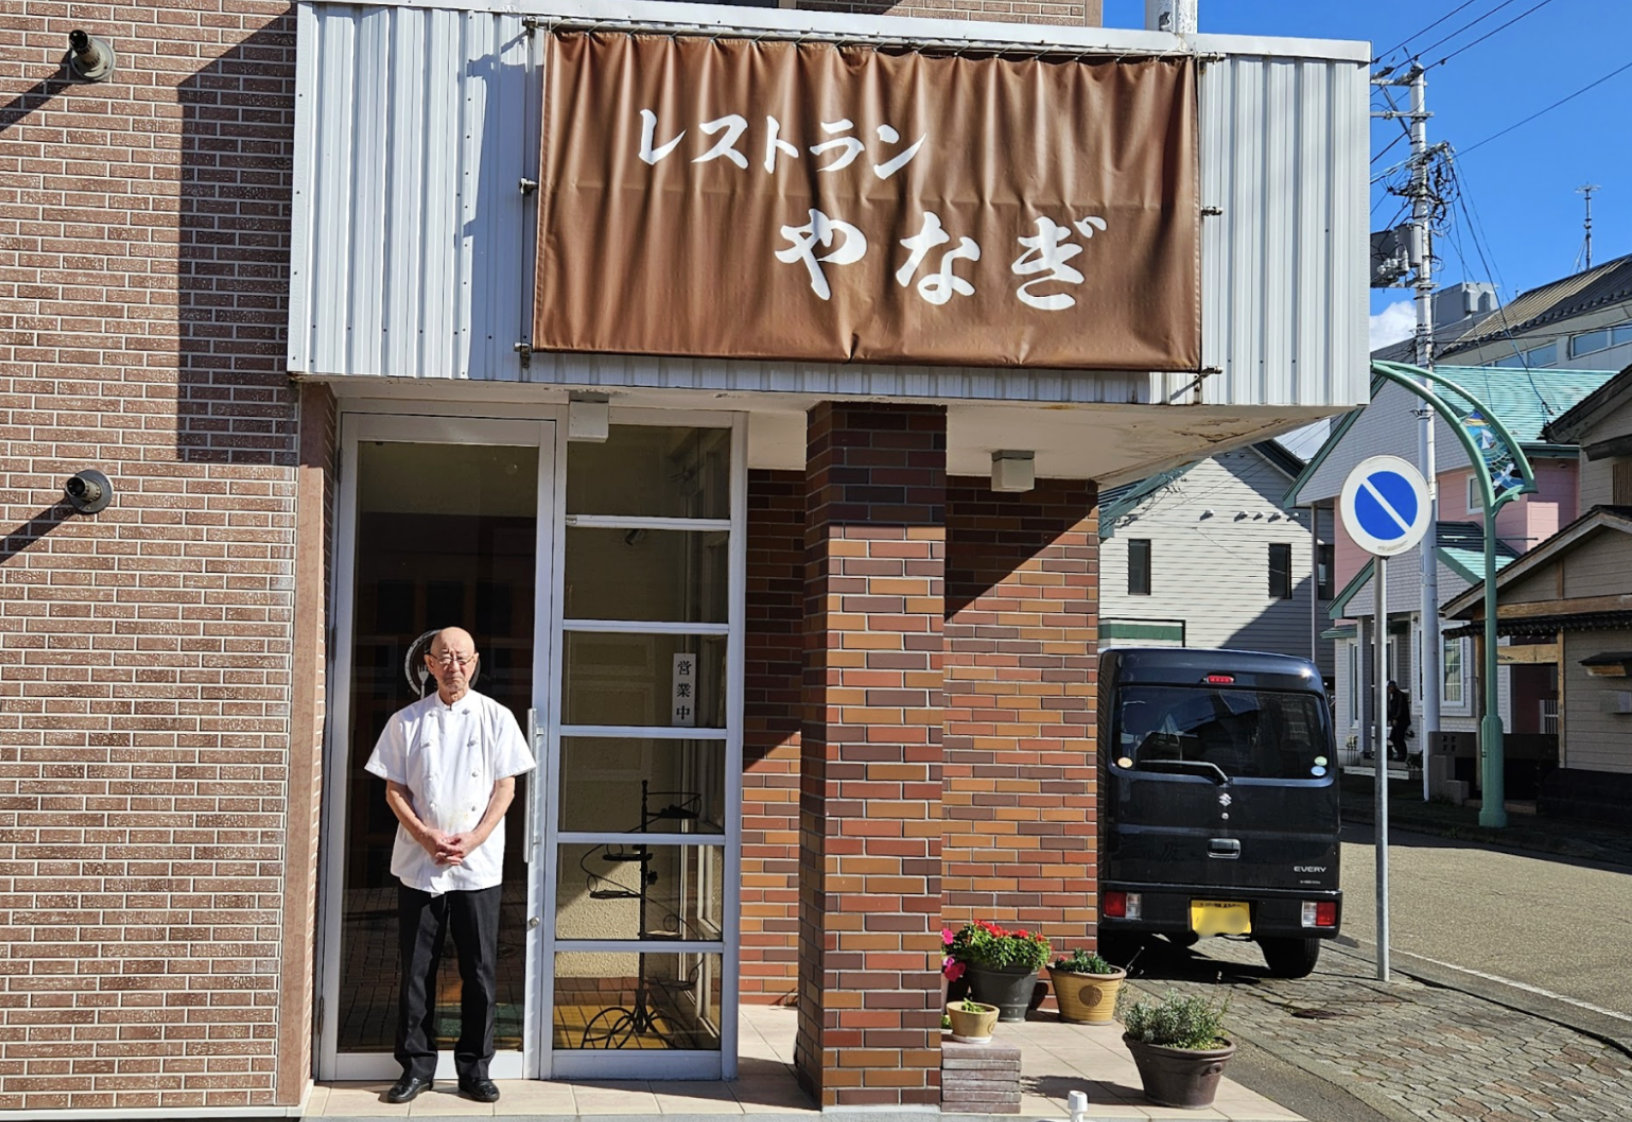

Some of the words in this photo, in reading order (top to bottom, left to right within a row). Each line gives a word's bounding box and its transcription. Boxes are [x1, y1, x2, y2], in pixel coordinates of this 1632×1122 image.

[638, 108, 927, 180] レストラン
[774, 208, 1107, 311] やなぎ
[676, 660, 692, 720] 営業中
[1293, 865, 1327, 873] EVERY
